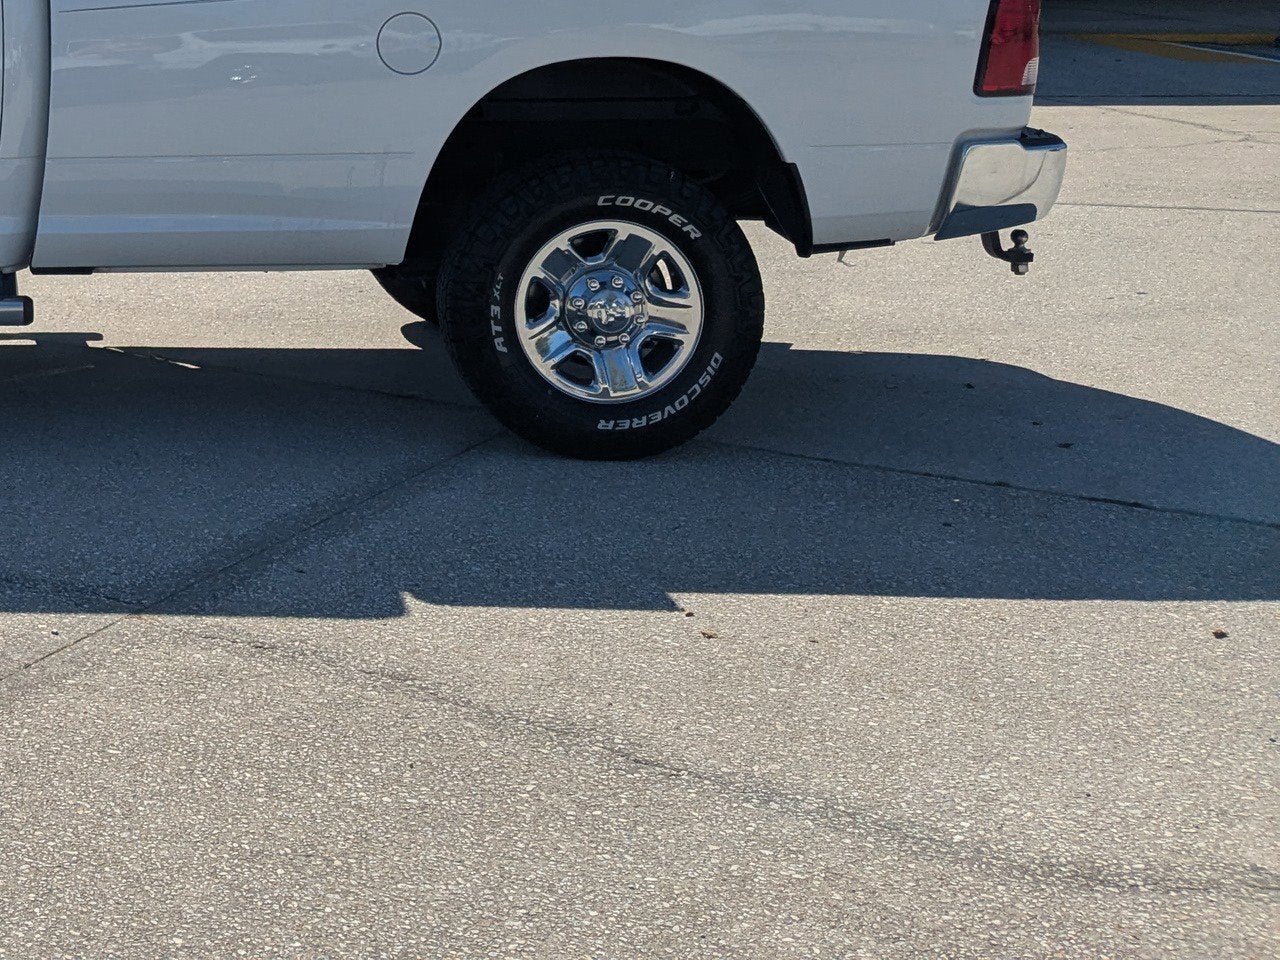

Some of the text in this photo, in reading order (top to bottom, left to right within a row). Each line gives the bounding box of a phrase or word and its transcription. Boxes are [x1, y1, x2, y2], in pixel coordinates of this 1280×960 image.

[597, 194, 702, 241] COOPER
[490, 303, 508, 353] AT3
[597, 351, 724, 431] DISCOVERER
